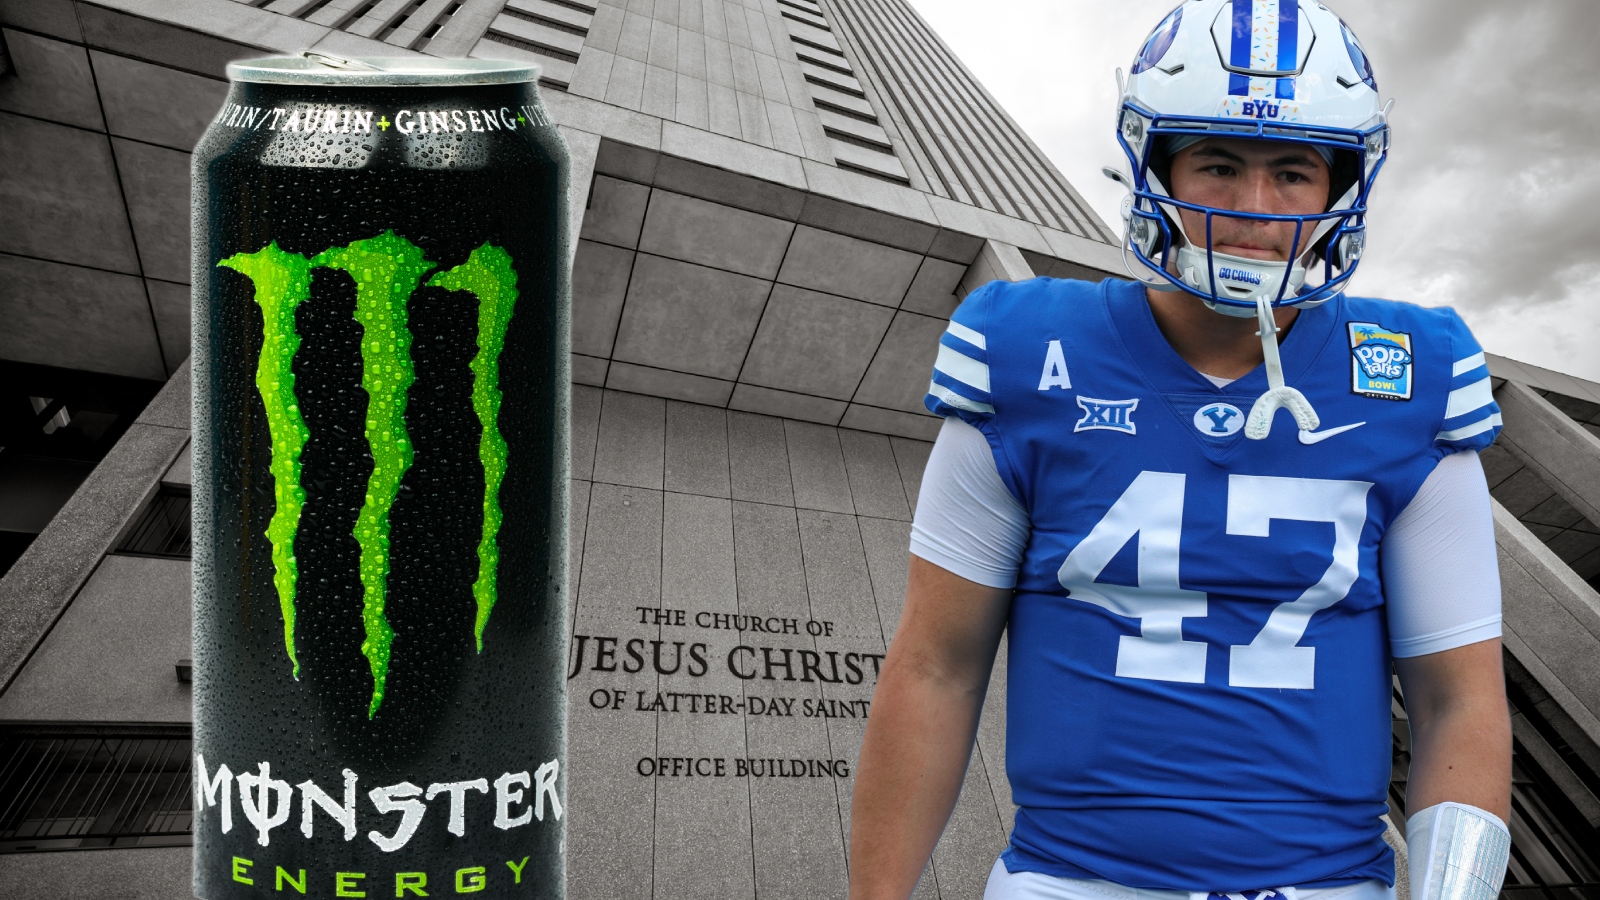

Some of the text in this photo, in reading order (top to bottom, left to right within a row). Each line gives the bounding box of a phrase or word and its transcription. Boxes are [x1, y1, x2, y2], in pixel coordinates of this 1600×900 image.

[395, 106, 517, 135] GINSENG
[1242, 99, 1279, 119] BYU
[1219, 267, 1261, 285] GO COUGS
[1038, 340, 1072, 391] A
[1365, 362, 1401, 376] tarts
[1368, 380, 1397, 391] BOWL
[1079, 400, 1135, 431] XII
[1202, 406, 1237, 432] Y
[1058, 470, 1375, 690] 47
[636, 606, 834, 637] THE CHURCH OF
[567, 635, 887, 685] JESUS CHRIST
[589, 688, 870, 719] OF LATTER-DAY SAINT
[636, 757, 850, 779] OFFICE BUILDING
[196, 754, 563, 852] MONSTER
[232, 856, 530, 899] ENERGY
